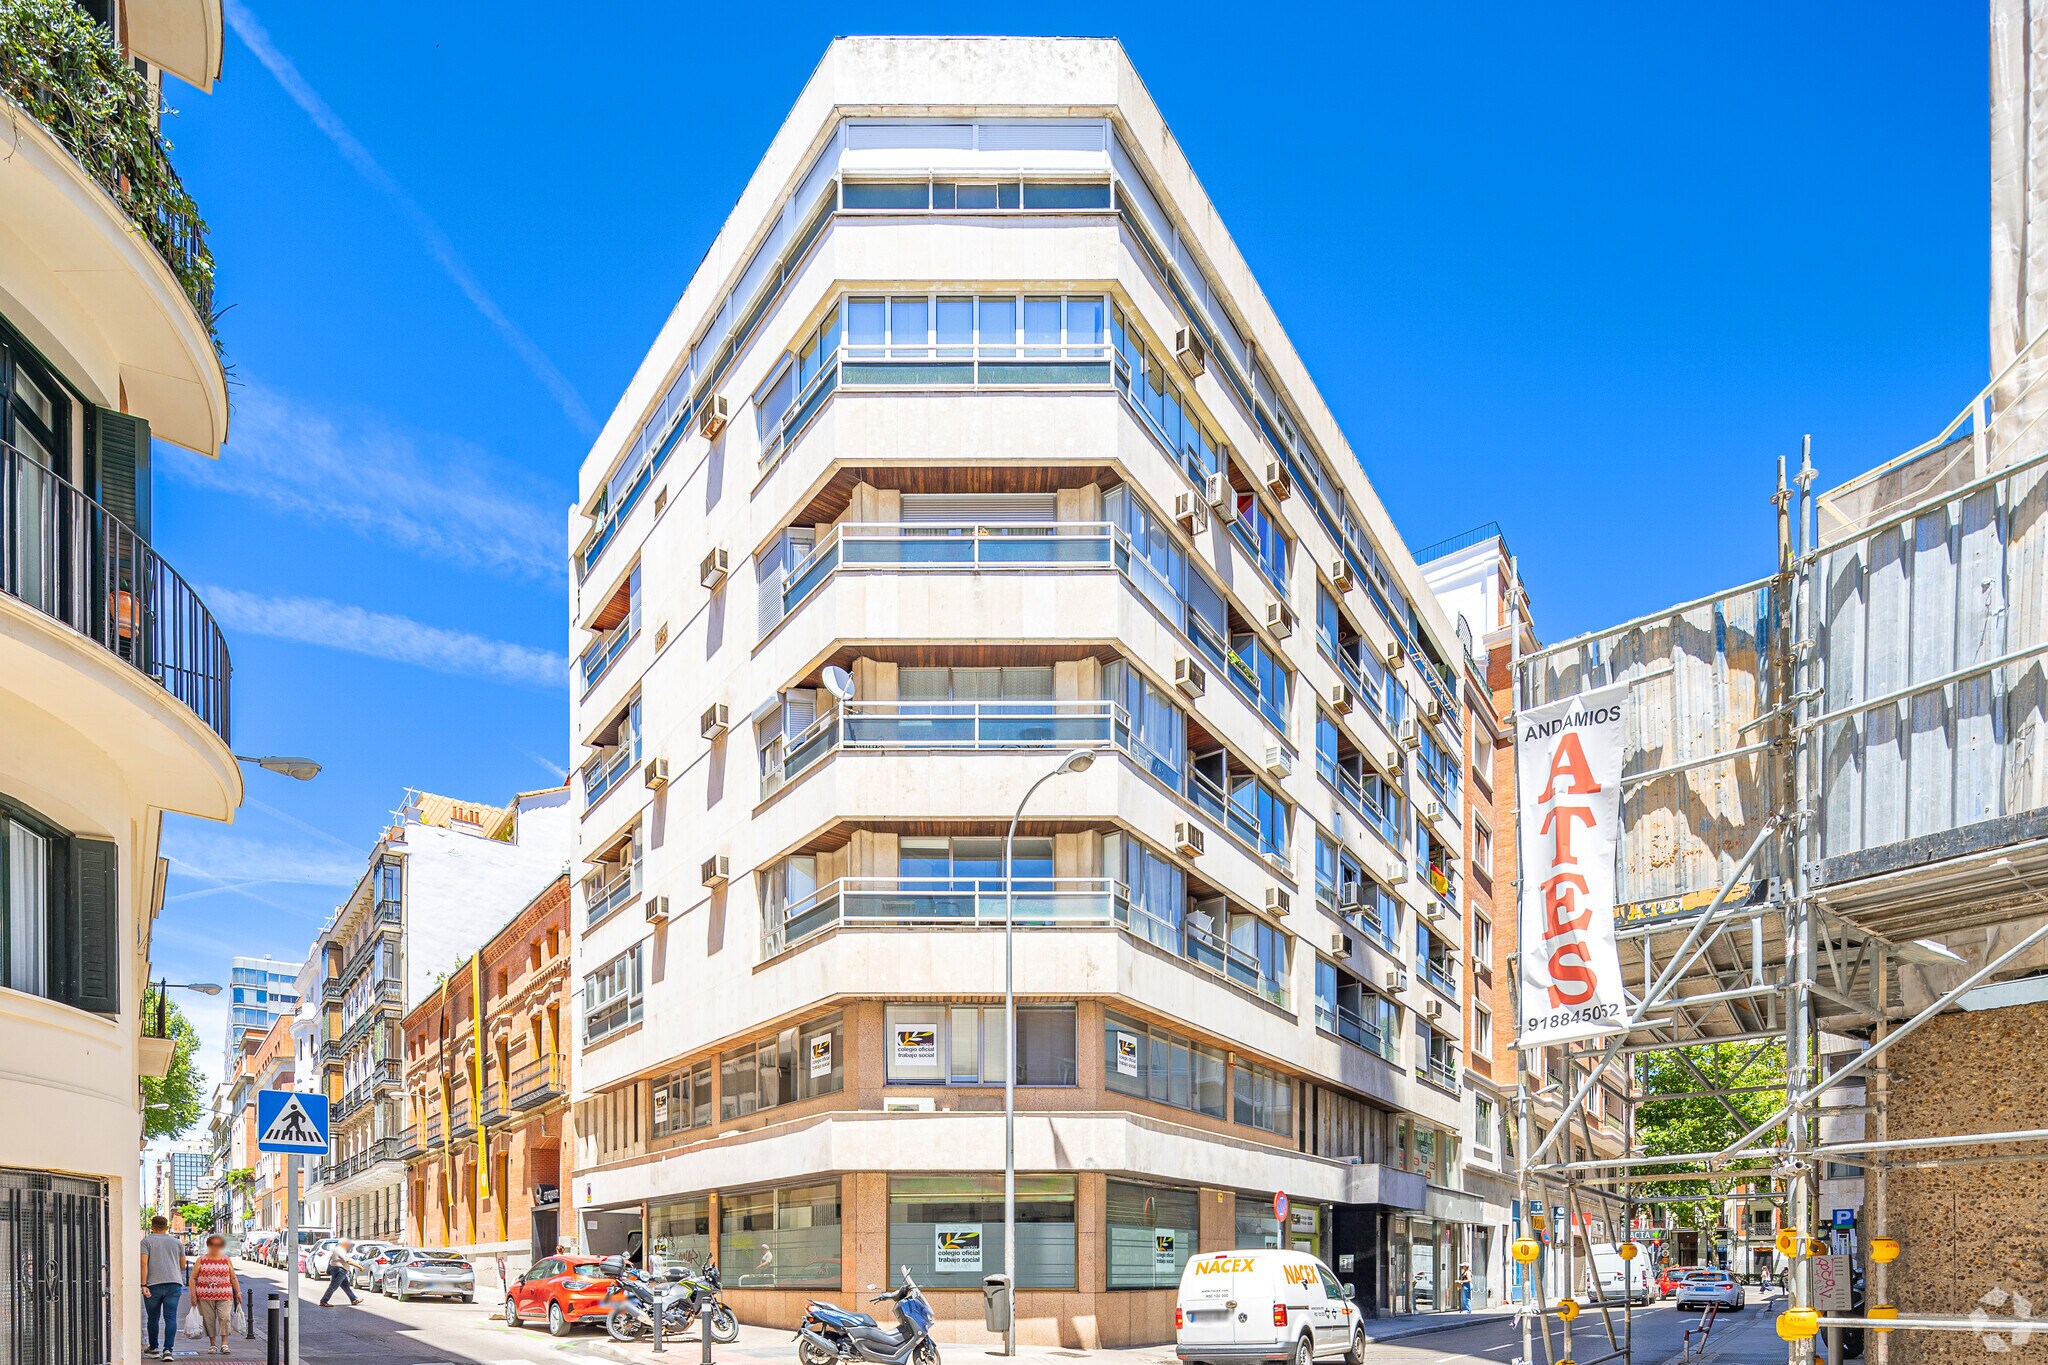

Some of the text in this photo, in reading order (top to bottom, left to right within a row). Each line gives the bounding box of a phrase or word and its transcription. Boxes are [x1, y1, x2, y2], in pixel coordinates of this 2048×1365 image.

[1525, 705, 1621, 741] ANDAMIOS
[1538, 732, 1602, 1009] ATES
[1528, 1003, 1620, 1031] 918845052
[1836, 1210, 1851, 1225] P
[1195, 1258, 1255, 1275] NACEX
[1283, 1264, 1318, 1284] NACEX
